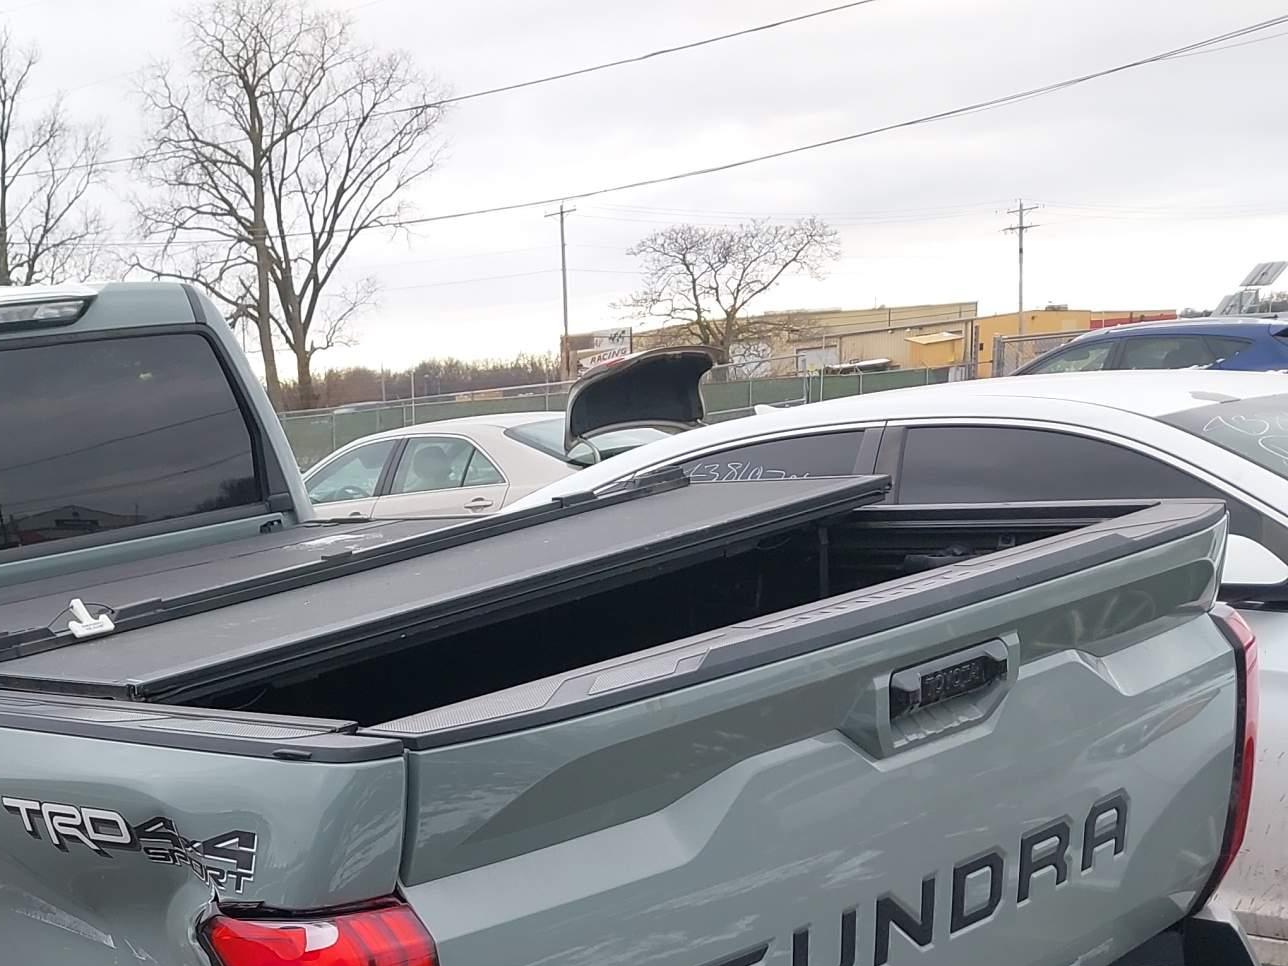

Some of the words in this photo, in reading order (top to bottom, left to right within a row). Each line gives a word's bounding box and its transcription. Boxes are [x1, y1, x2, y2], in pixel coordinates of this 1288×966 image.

[590, 348, 628, 365] RACING
[1, 796, 139, 857] TRD
[143, 847, 254, 894] SPORT
